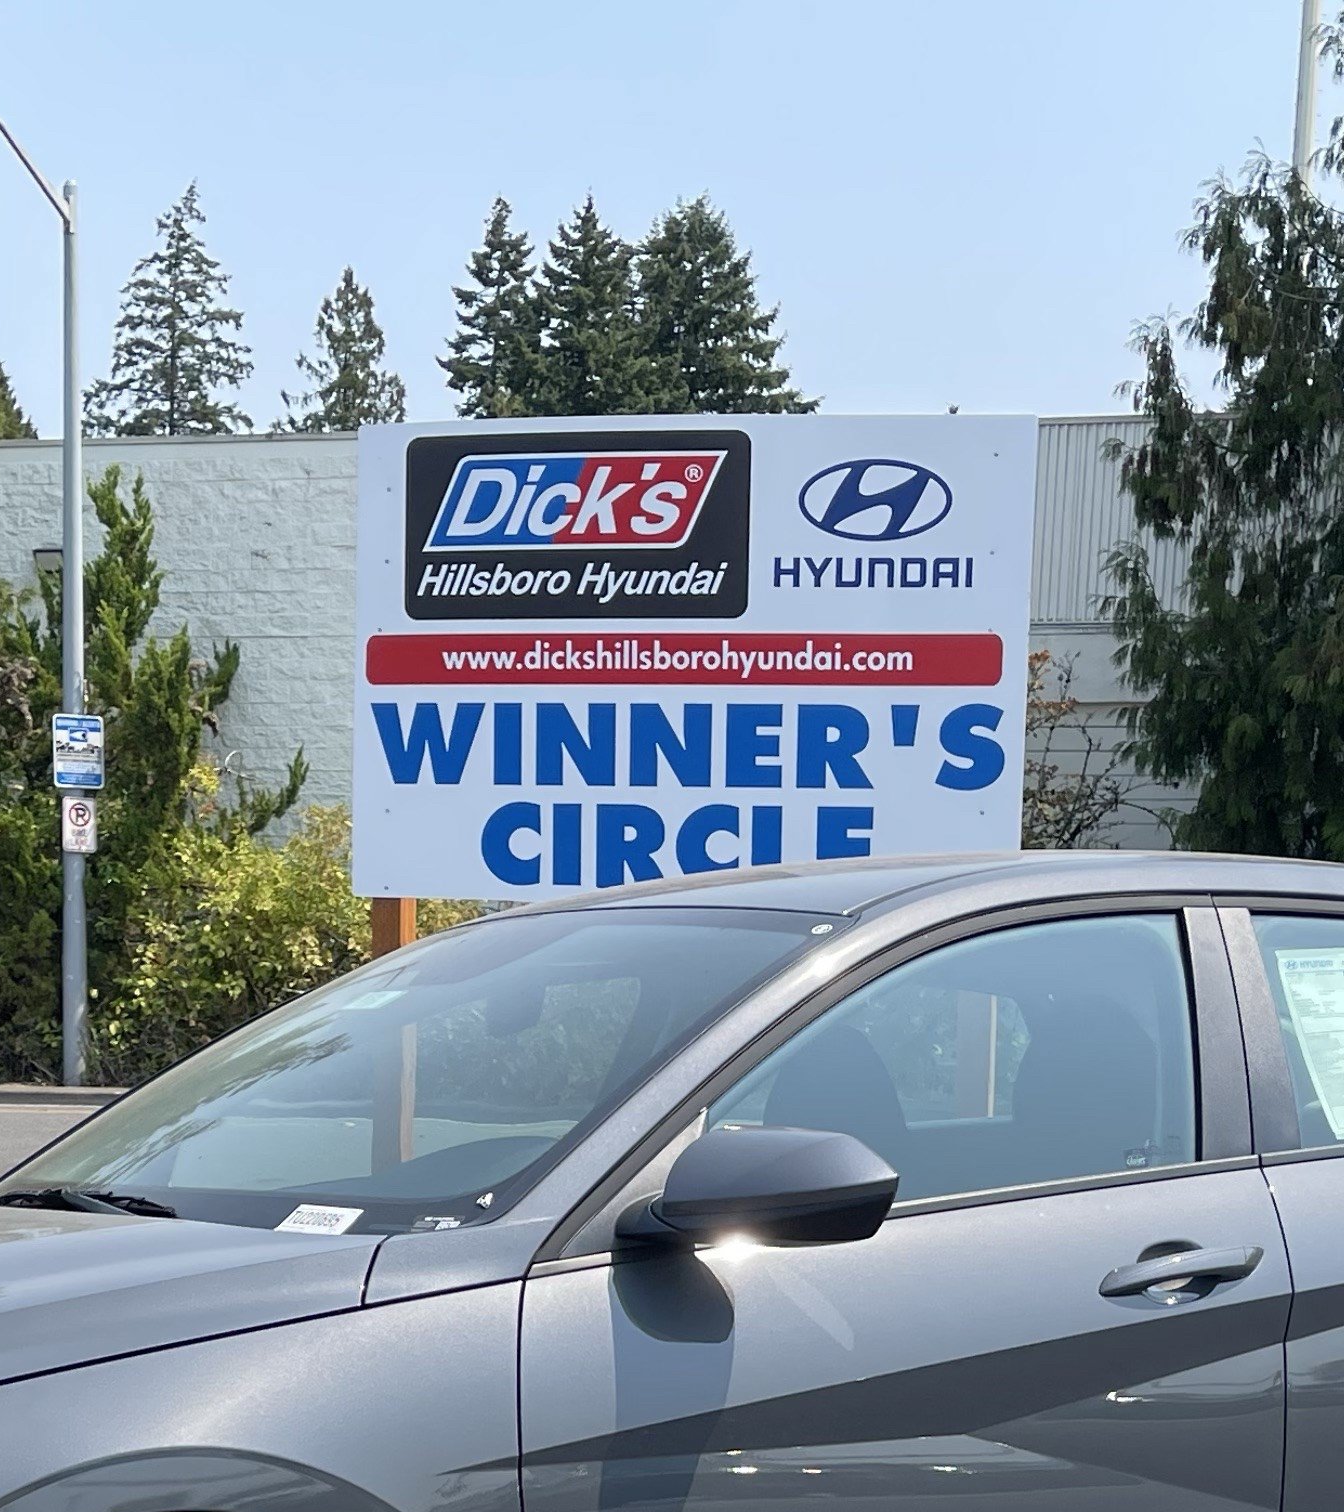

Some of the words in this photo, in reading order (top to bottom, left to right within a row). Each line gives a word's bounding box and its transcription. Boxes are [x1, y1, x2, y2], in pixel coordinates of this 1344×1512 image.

[417, 563, 570, 597] Hillsboro
[577, 562, 728, 604] Hyundai
[774, 557, 973, 588] HYUNDAI
[443, 641, 913, 679] www.dickshillsborohyundai.com
[371, 702, 1006, 791] WINNER'S
